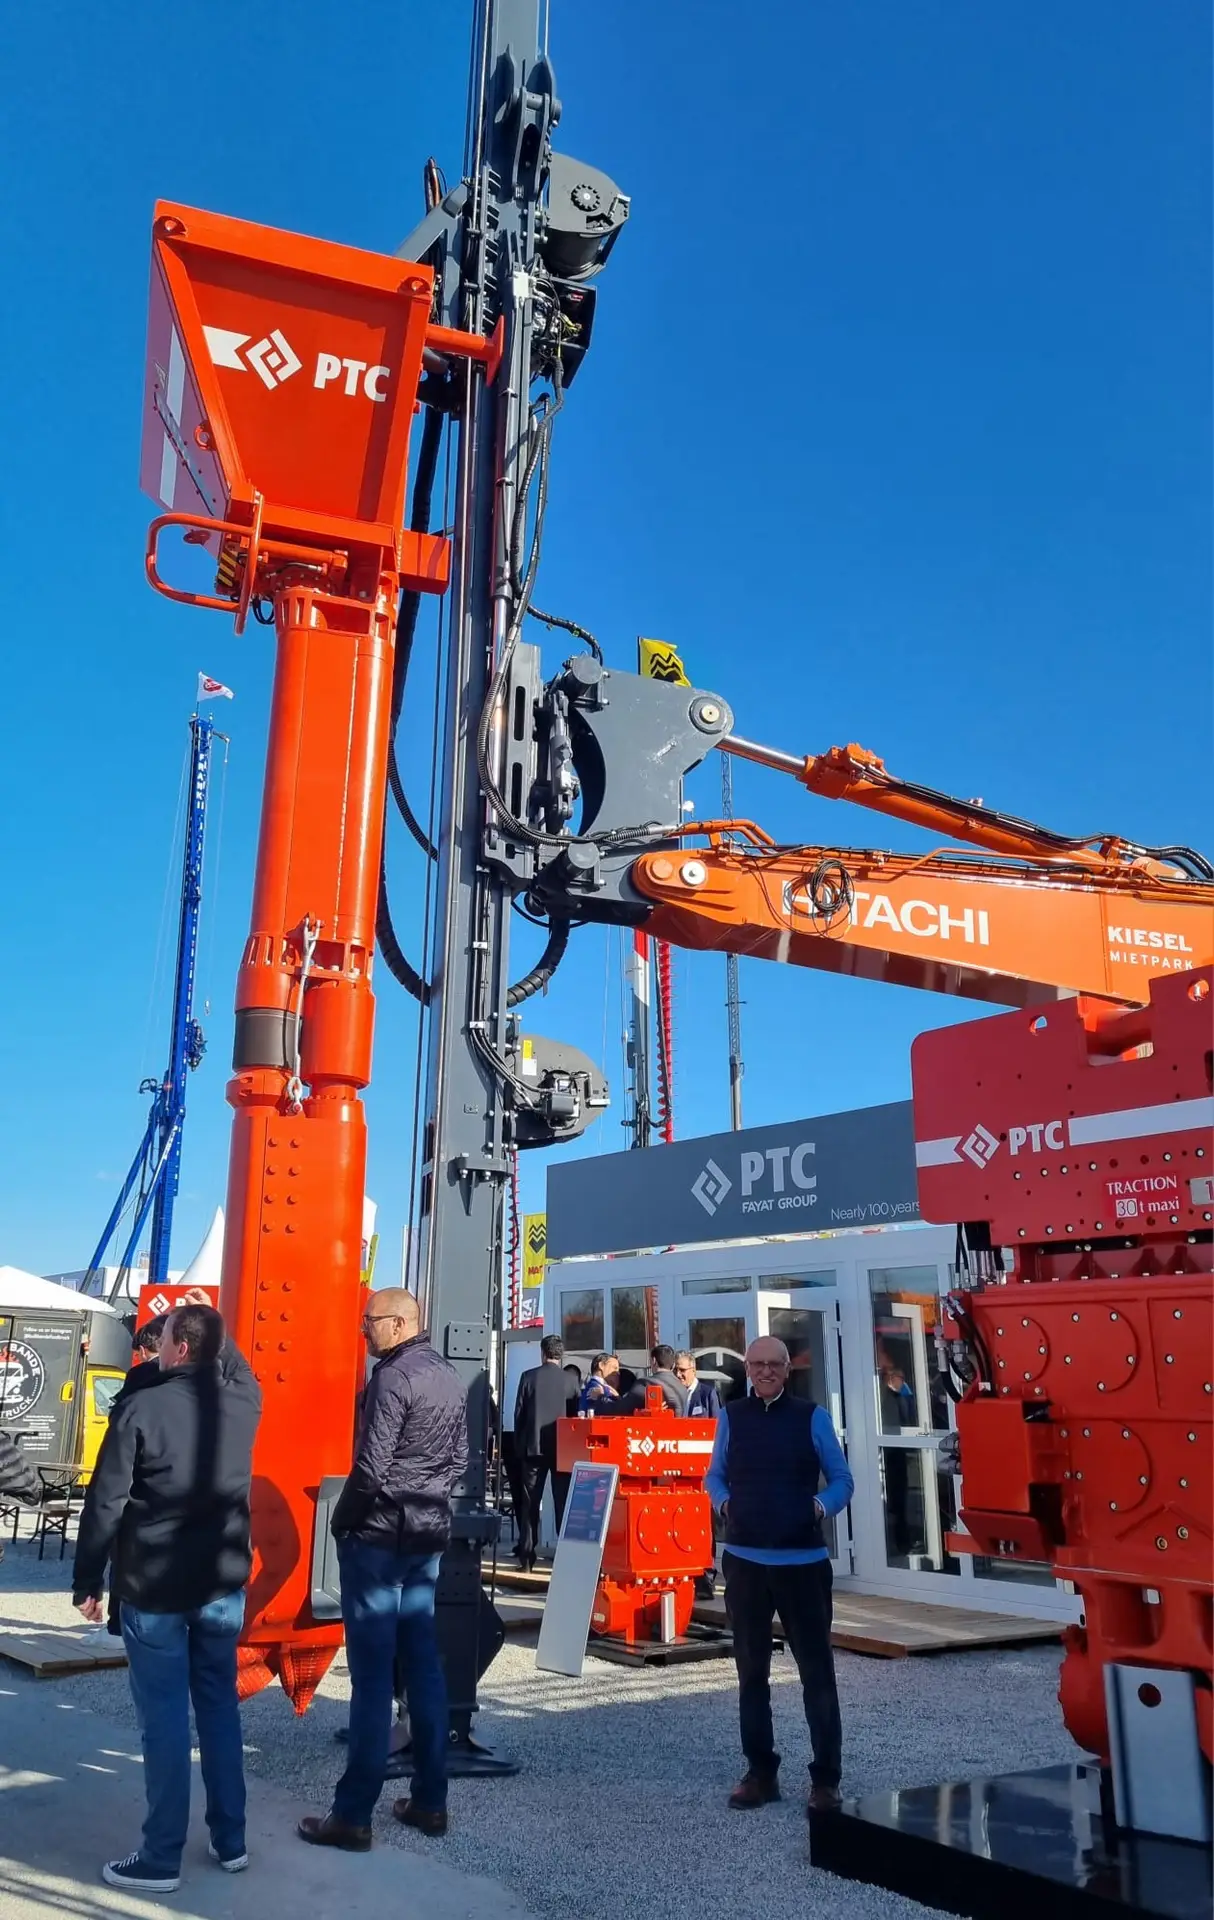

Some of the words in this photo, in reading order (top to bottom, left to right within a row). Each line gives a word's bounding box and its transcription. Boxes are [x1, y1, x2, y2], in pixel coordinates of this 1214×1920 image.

[313, 352, 391, 402] PTC
[1107, 925, 1193, 952] KIESEL
[1109, 950, 1193, 970] MIETPARK
[1008, 1120, 1064, 1155] PTC
[740, 1142, 817, 1196] PTC
[1105, 1175, 1178, 1195] TRACTION
[742, 1199, 774, 1214] FAYAT
[777, 1194, 818, 1210] GROUP
[831, 1203, 867, 1221] Nearly
[867, 1202, 889, 1217] 100
[1116, 1199, 1137, 1217] 30
[1147, 1196, 1180, 1213] maxi
[9, 1342, 41, 1377] BANDE
[657, 1440, 678, 1454] PTC
